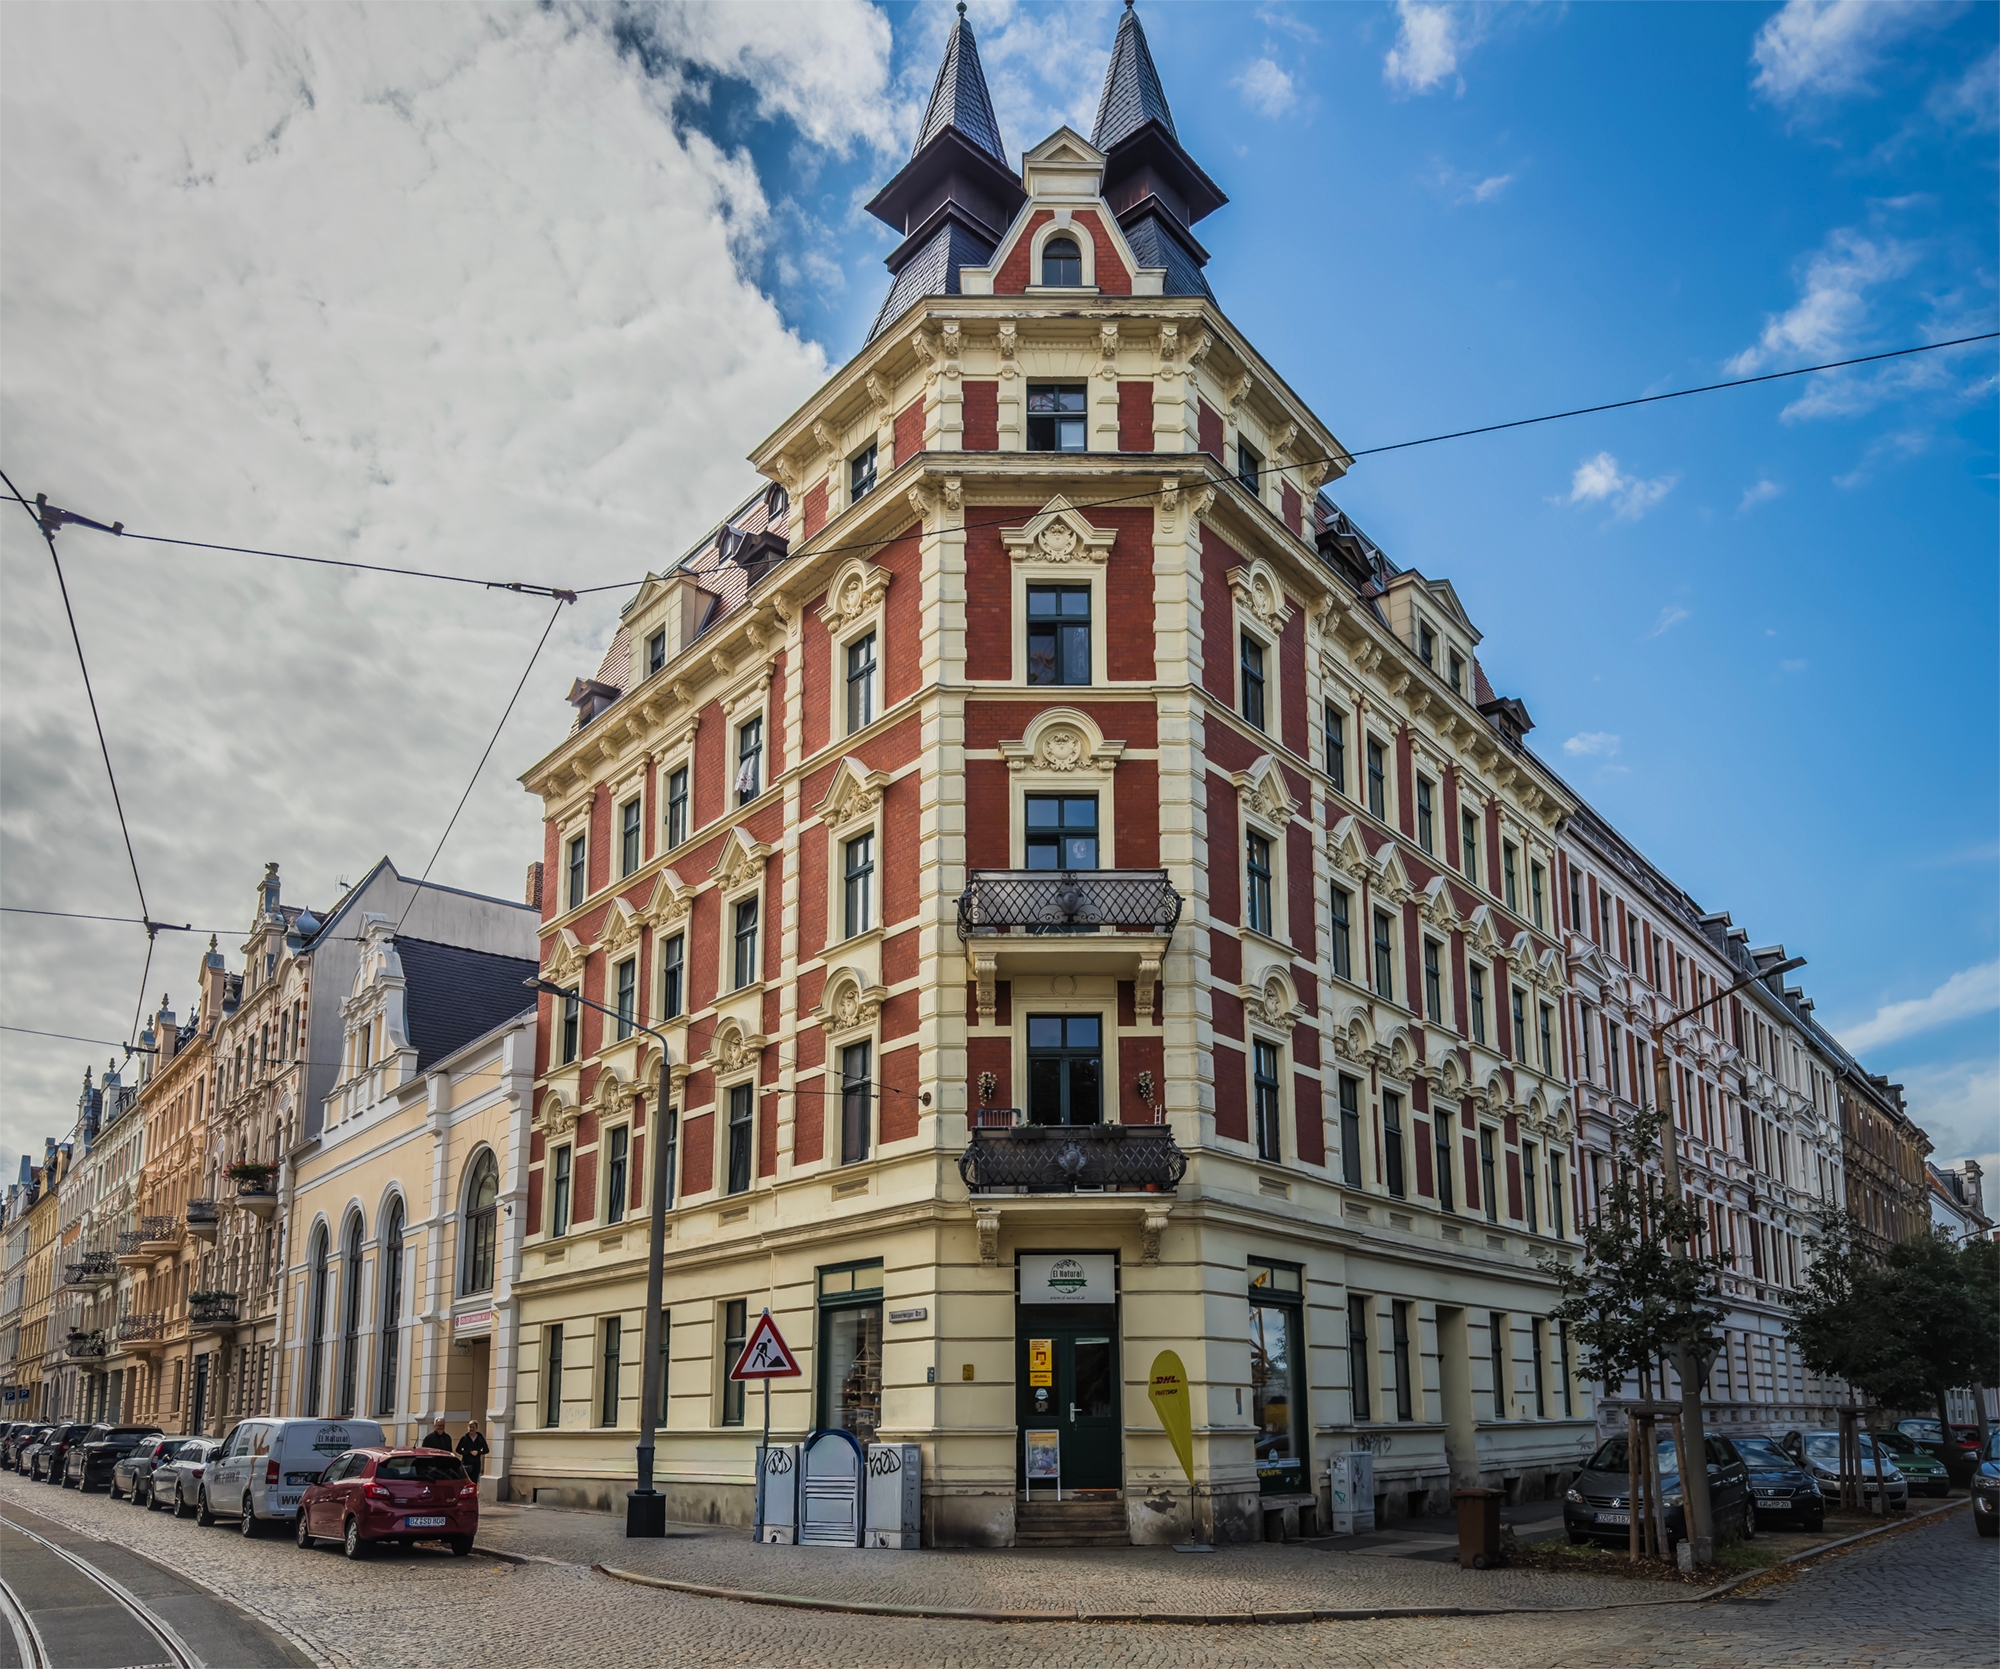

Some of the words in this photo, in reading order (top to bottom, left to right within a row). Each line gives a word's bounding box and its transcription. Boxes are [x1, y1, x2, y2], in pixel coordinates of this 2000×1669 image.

[1052, 1270, 1058, 1278] El
[1060, 1270, 1082, 1278] Natural
[1153, 1375, 1179, 1384] DHL
